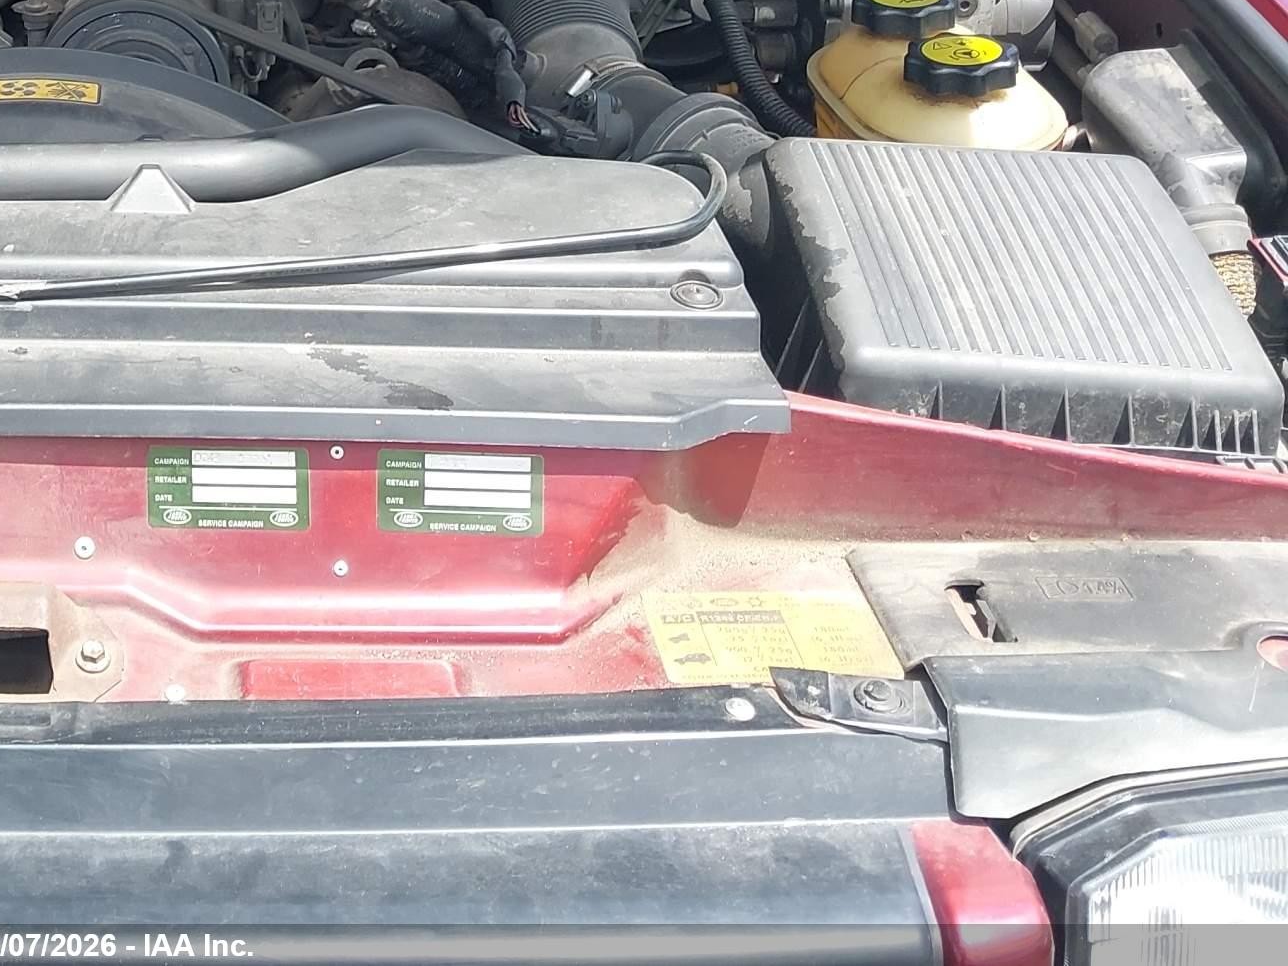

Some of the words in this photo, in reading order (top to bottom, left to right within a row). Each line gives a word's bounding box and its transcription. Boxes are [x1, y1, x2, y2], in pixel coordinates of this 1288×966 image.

[154, 458, 190, 466] CAMPAIGN
[154, 476, 187, 484] RETAILER
[386, 479, 420, 487] RETAILER
[154, 494, 173, 502] DATE
[386, 497, 404, 505] DATE
[198, 520, 227, 528] SERVICE
[228, 520, 264, 528] CAMPAIGN
[460, 524, 497, 532] CAMPAIGN
